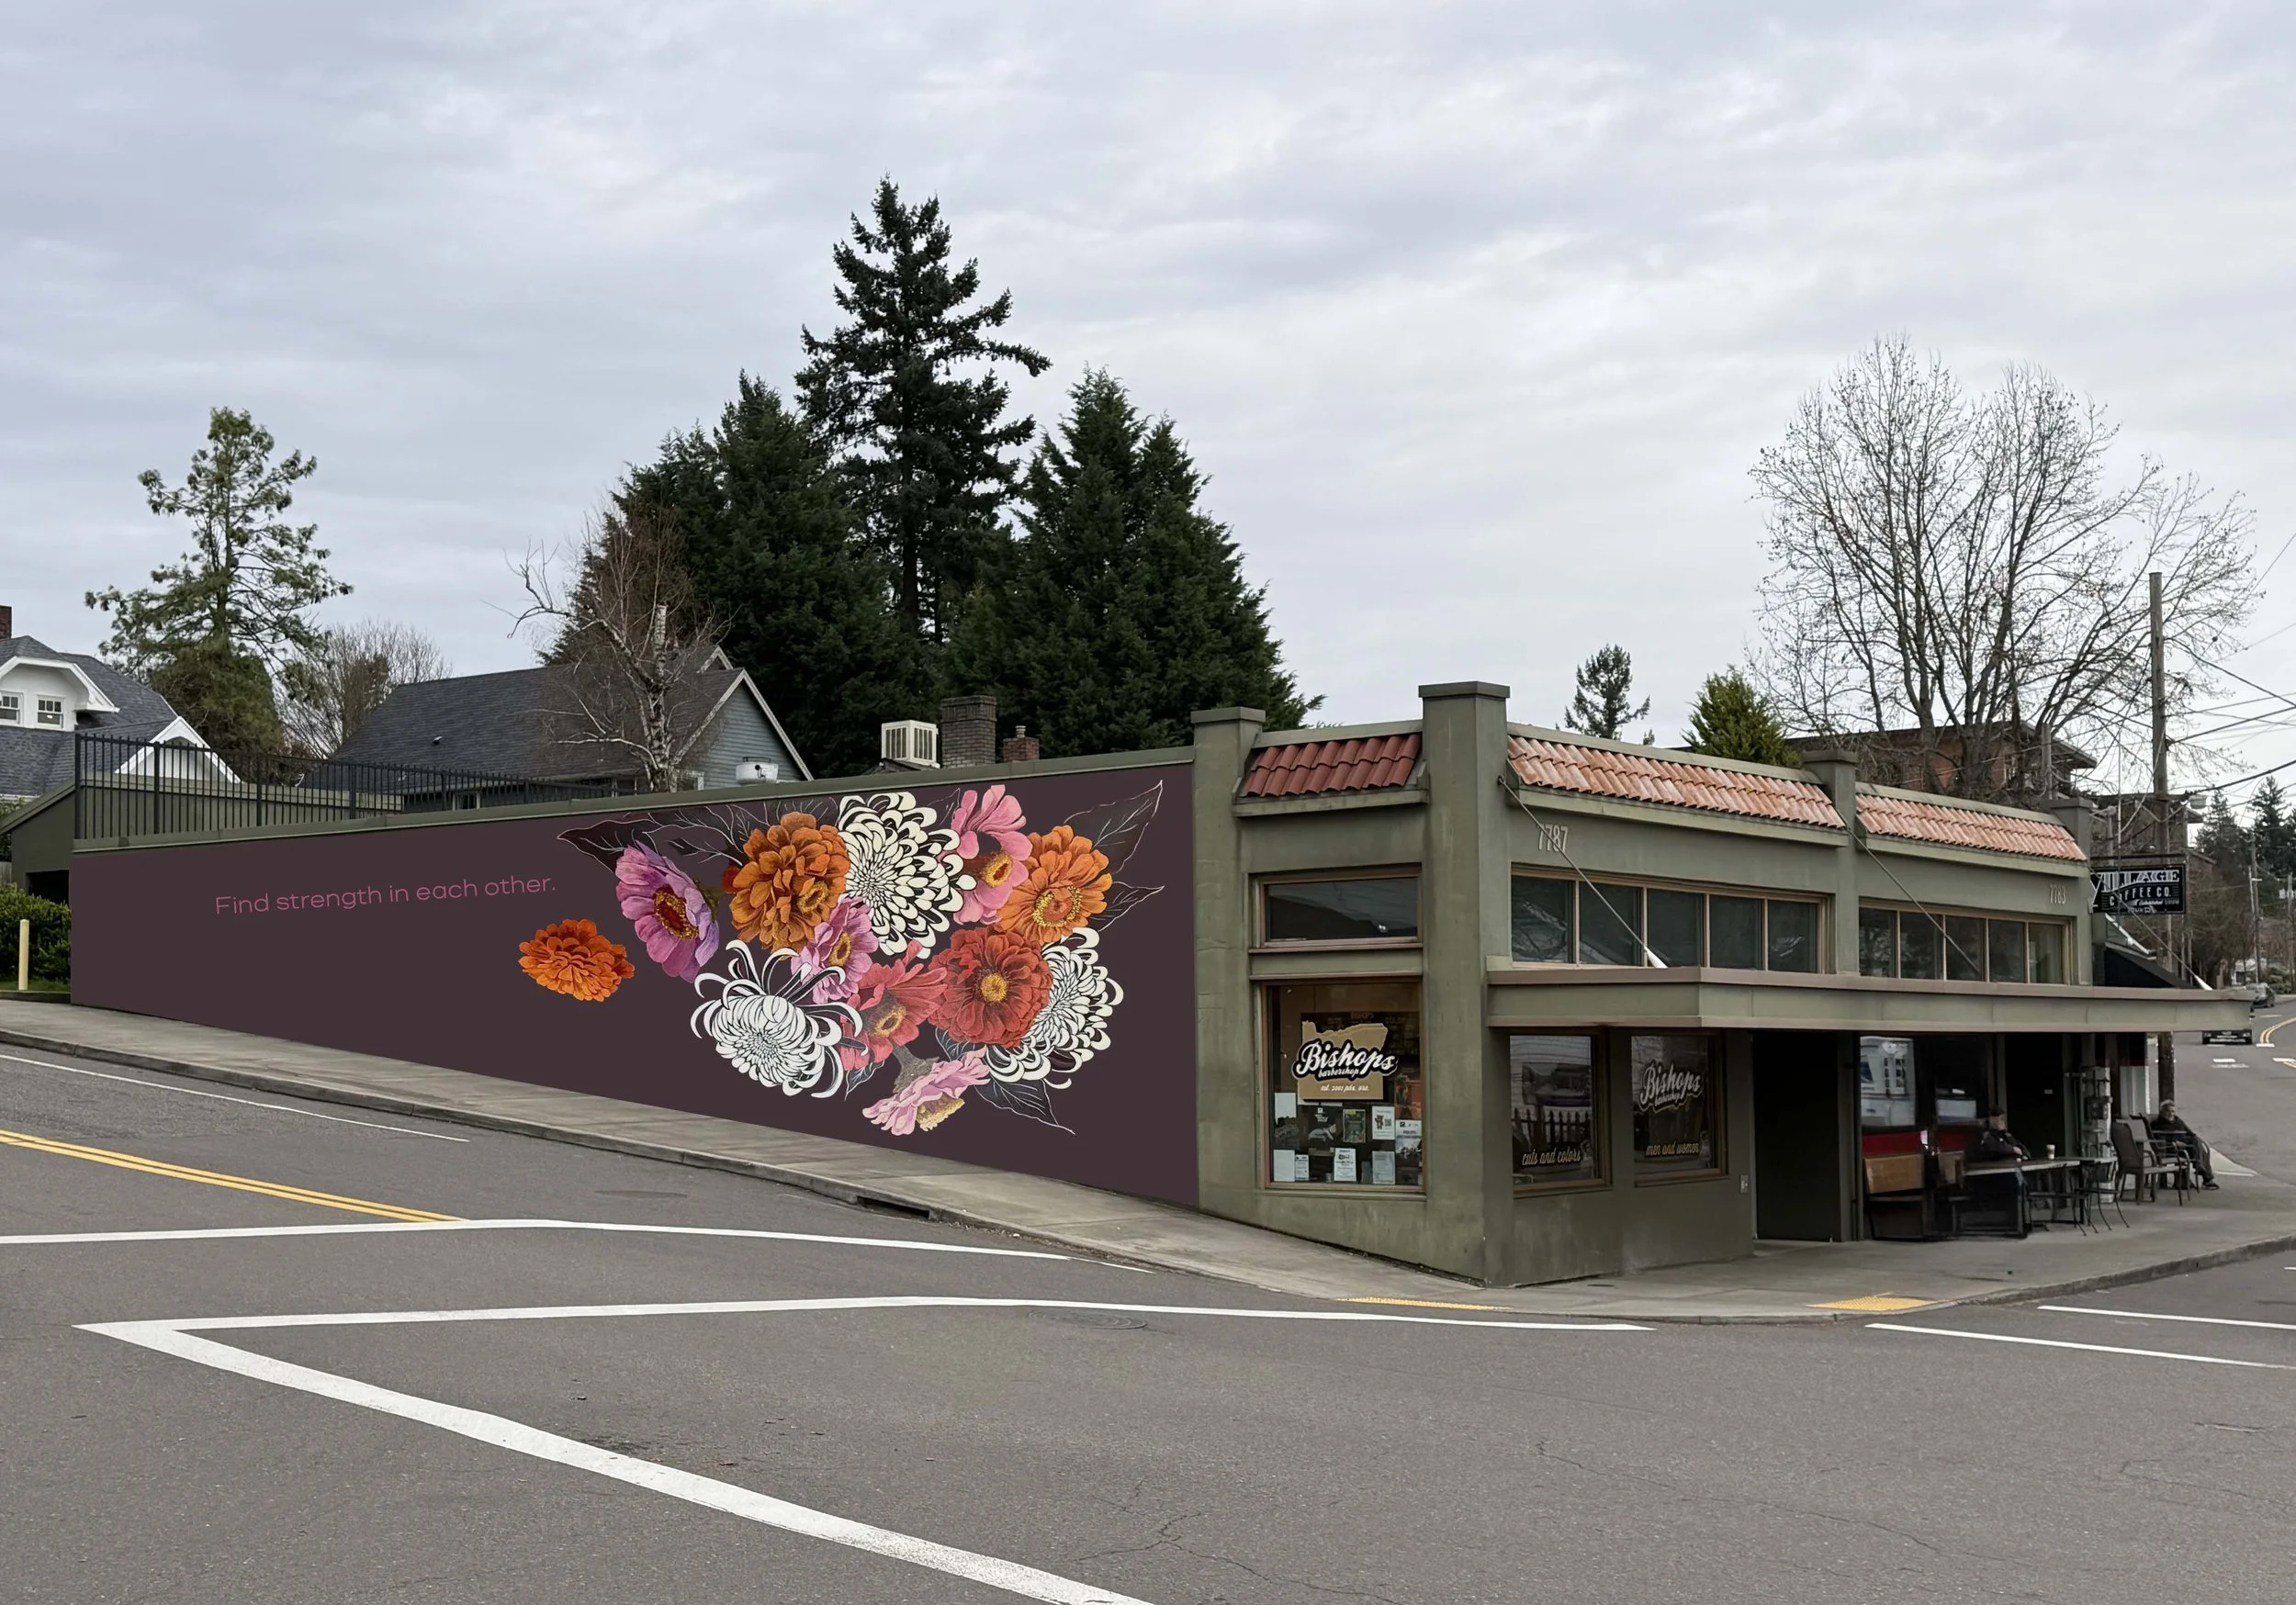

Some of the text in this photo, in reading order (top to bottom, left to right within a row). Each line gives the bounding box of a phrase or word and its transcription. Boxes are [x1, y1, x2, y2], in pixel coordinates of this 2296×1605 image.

[1537, 824, 1569, 852] 7787
[216, 875, 556, 915] Find strength in each other.
[2049, 883, 2066, 904] 7783
[2089, 870, 2179, 907] VILLAGE
[2156, 886, 2172, 897] CO.
[1296, 1041, 1396, 1075] Bishops
[1318, 1066, 1359, 1078] barbershop
[1640, 1063, 1701, 1105] Bishops
[1522, 1146, 1581, 1166] cuts and colors
